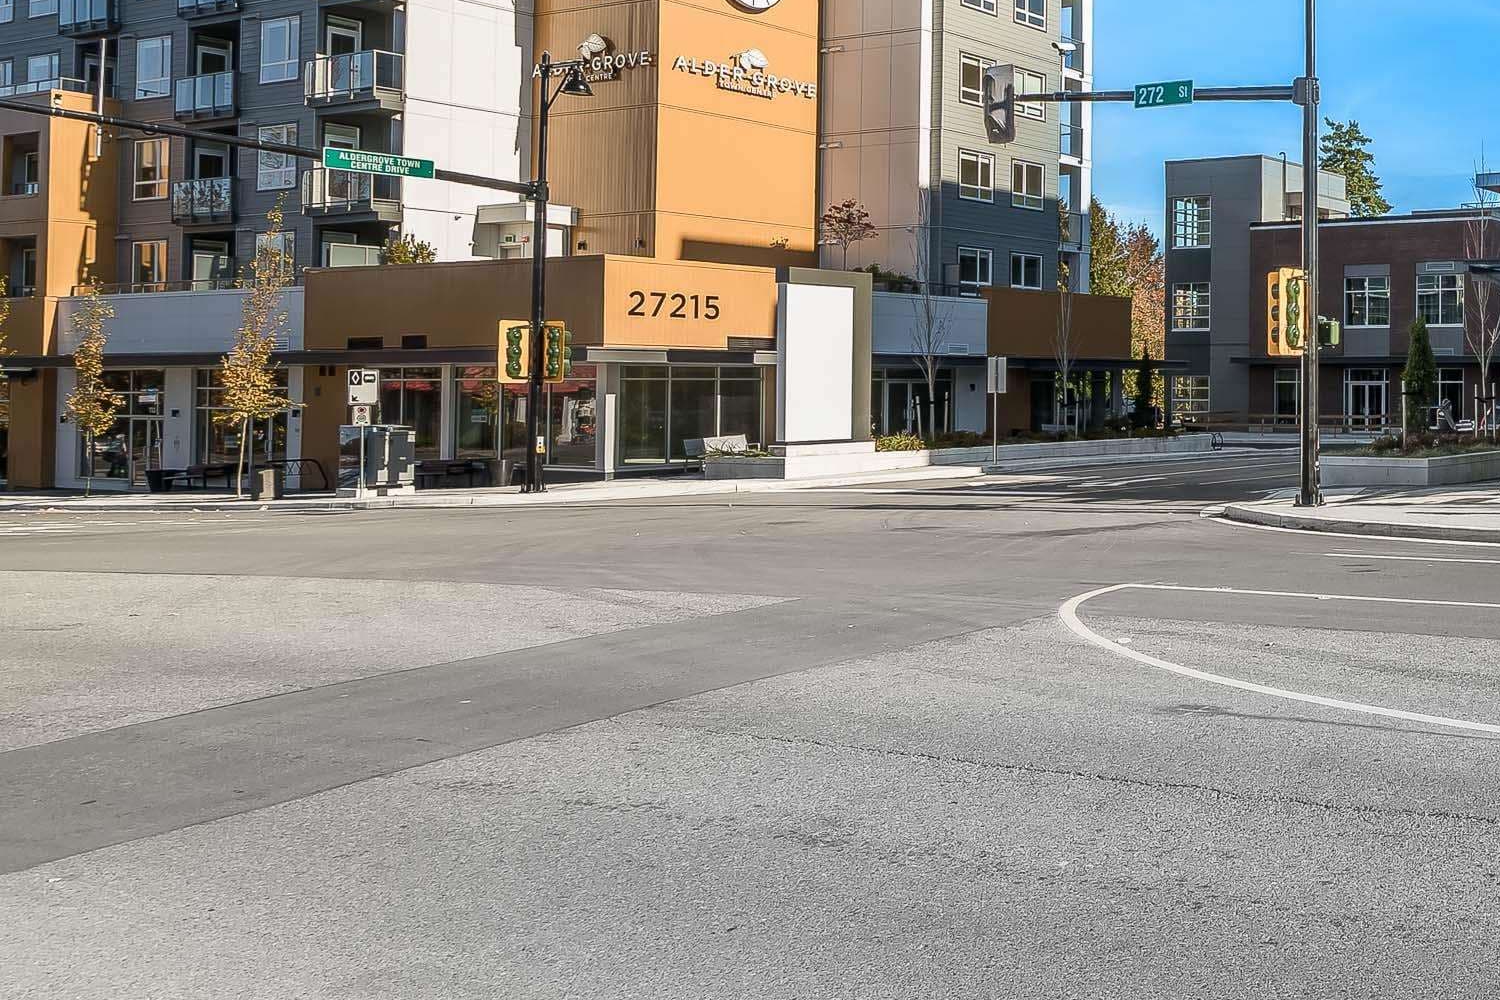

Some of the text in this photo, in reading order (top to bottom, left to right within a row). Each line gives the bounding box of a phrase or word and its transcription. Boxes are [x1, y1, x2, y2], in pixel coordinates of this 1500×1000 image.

[591, 51, 650, 71] GROVE
[675, 55, 817, 98] ALDER GROVE
[1139, 85, 1188, 105] 272 St
[338, 152, 421, 169] ALDERGROVE TOWN
[350, 161, 410, 175] CENTRE DRIVE
[627, 290, 720, 320] 27215
